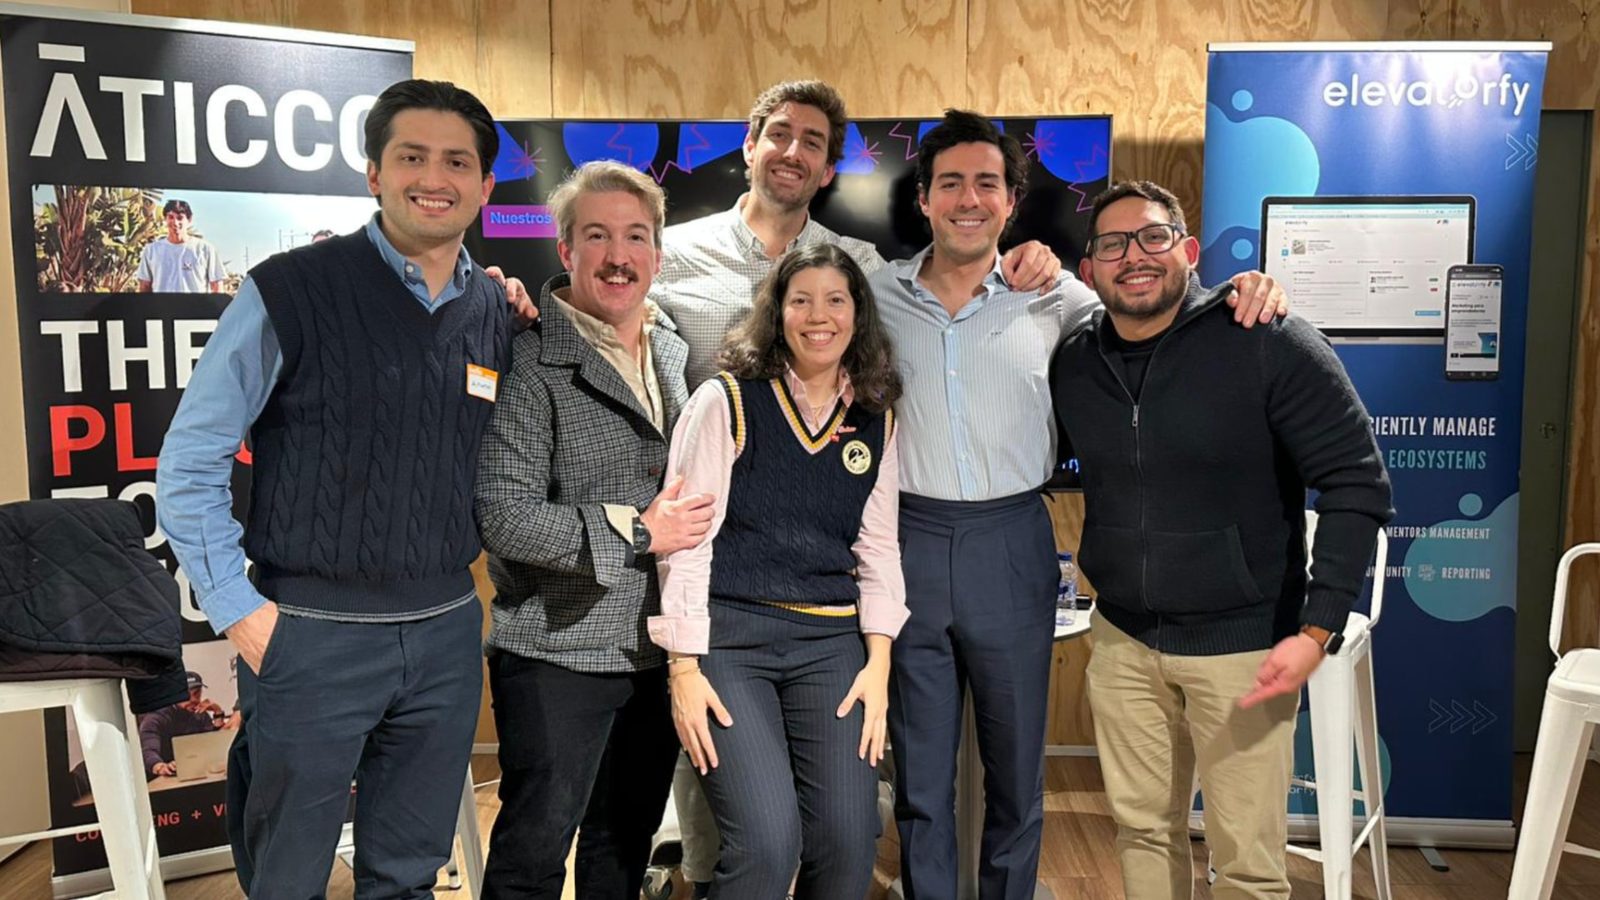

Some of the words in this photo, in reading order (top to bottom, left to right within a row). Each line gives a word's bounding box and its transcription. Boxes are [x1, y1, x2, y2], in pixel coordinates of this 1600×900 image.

[1323, 73, 1530, 116] elevatorfy
[490, 211, 552, 224] Nuestros
[1432, 416, 1496, 436] MANAGE
[1388, 449, 1487, 470] ECOSYSTEMS
[1386, 526, 1426, 538] MENTORS
[1429, 527, 1491, 539] MANAGEMENT
[1441, 567, 1491, 579] REPORTING
